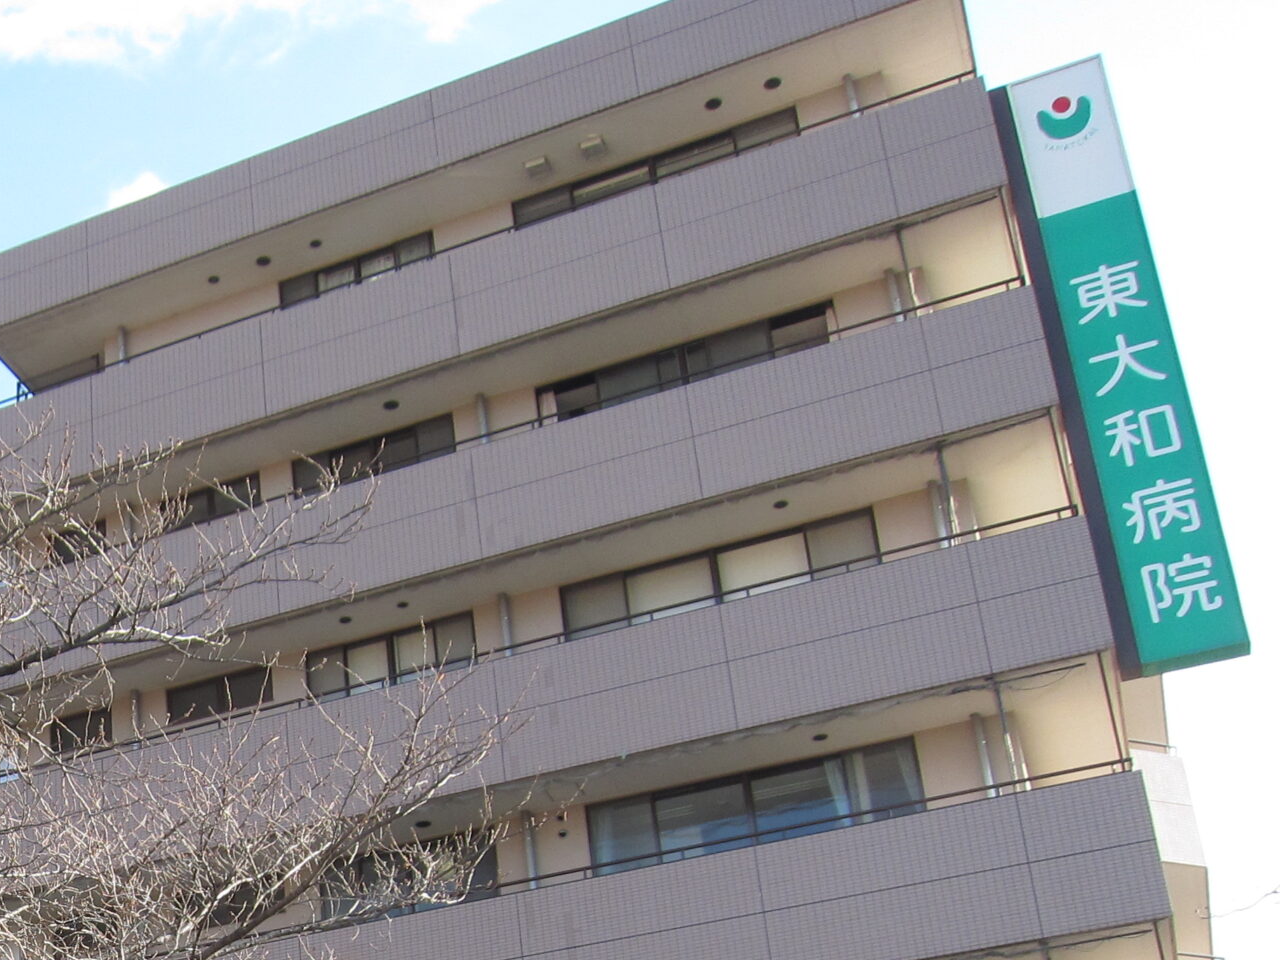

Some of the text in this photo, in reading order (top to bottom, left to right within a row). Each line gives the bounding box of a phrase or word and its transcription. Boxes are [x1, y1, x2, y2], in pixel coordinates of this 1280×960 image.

[1069, 259, 1223, 624] 東大和病院
